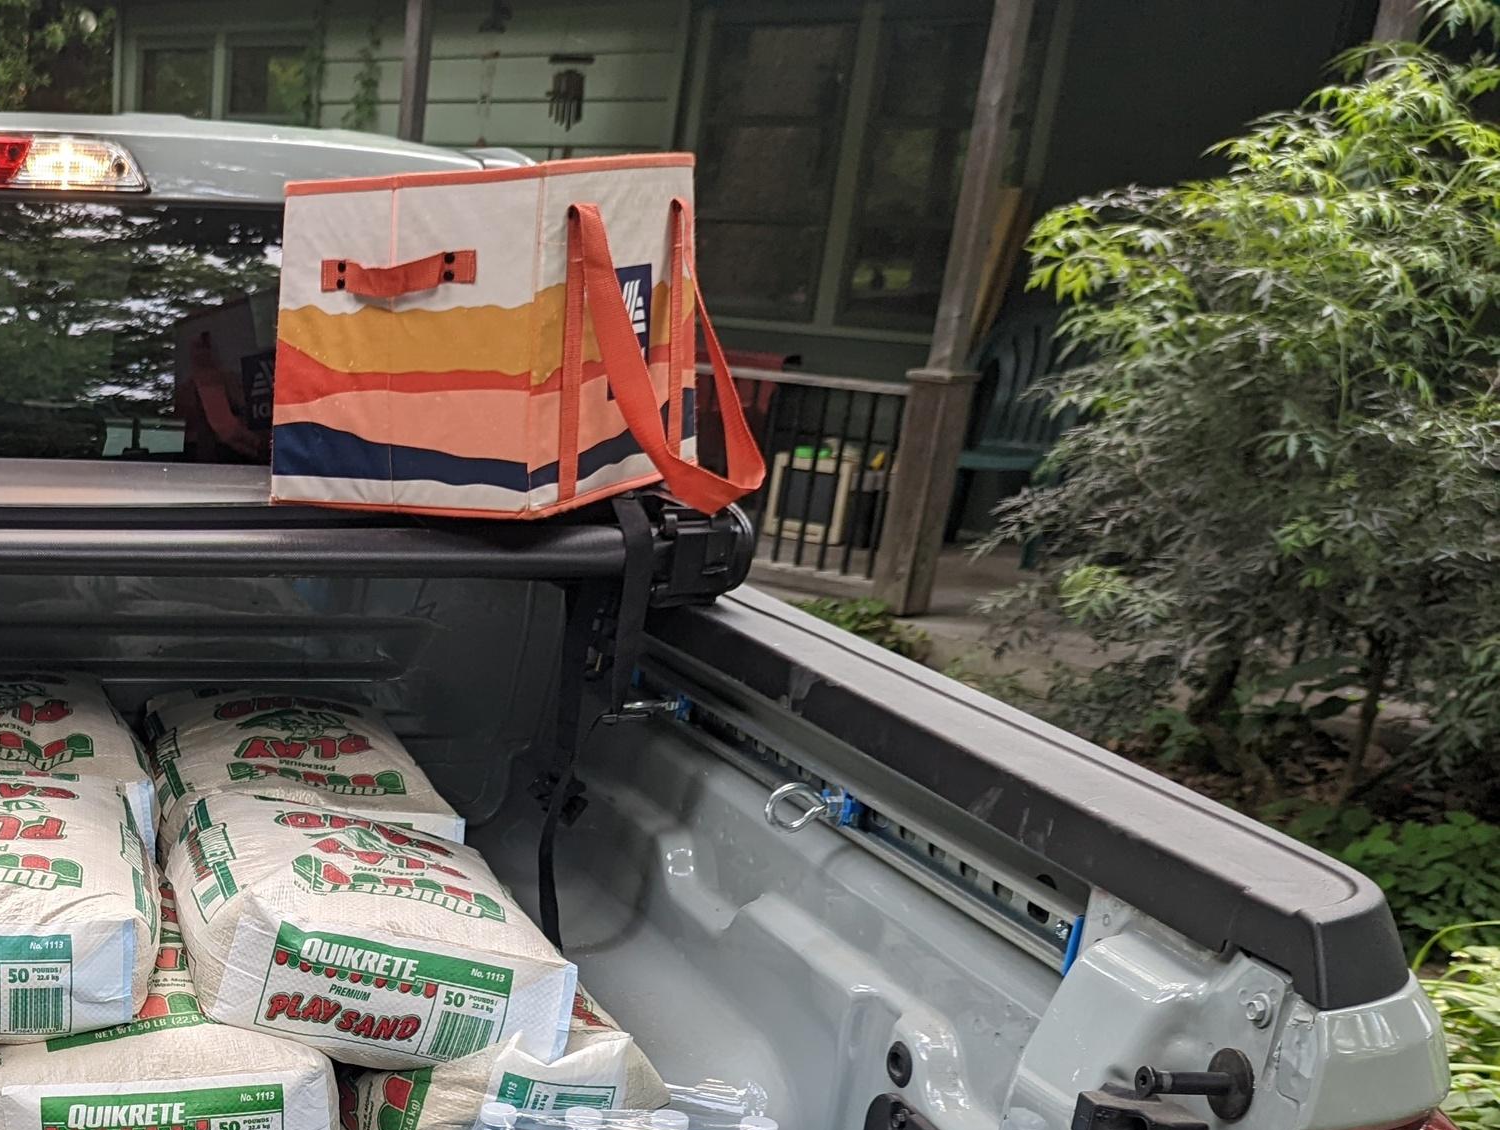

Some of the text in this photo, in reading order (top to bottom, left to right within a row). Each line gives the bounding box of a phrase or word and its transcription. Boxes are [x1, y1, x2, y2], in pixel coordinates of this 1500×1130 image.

[234, 734, 372, 760] PLAY
[313, 879, 484, 918] QUIKRETE
[30, 941, 63, 950] No. 1113
[299, 938, 419, 981] QUIKRETE
[8, 968, 29, 983] 50
[470, 968, 505, 982] No. 1113
[329, 984, 371, 1002] PREMIUM
[443, 990, 465, 1008] 50
[95, 1030, 113, 1040] NET
[137, 1021, 151, 1031] 50
[154, 1018, 167, 1026] LB
[171, 1014, 199, 1026] (22.6
[264, 992, 421, 1042] PLAY SAND
[240, 1092, 275, 1102] No. 1113
[68, 1102, 186, 1129] QUIKRETE
